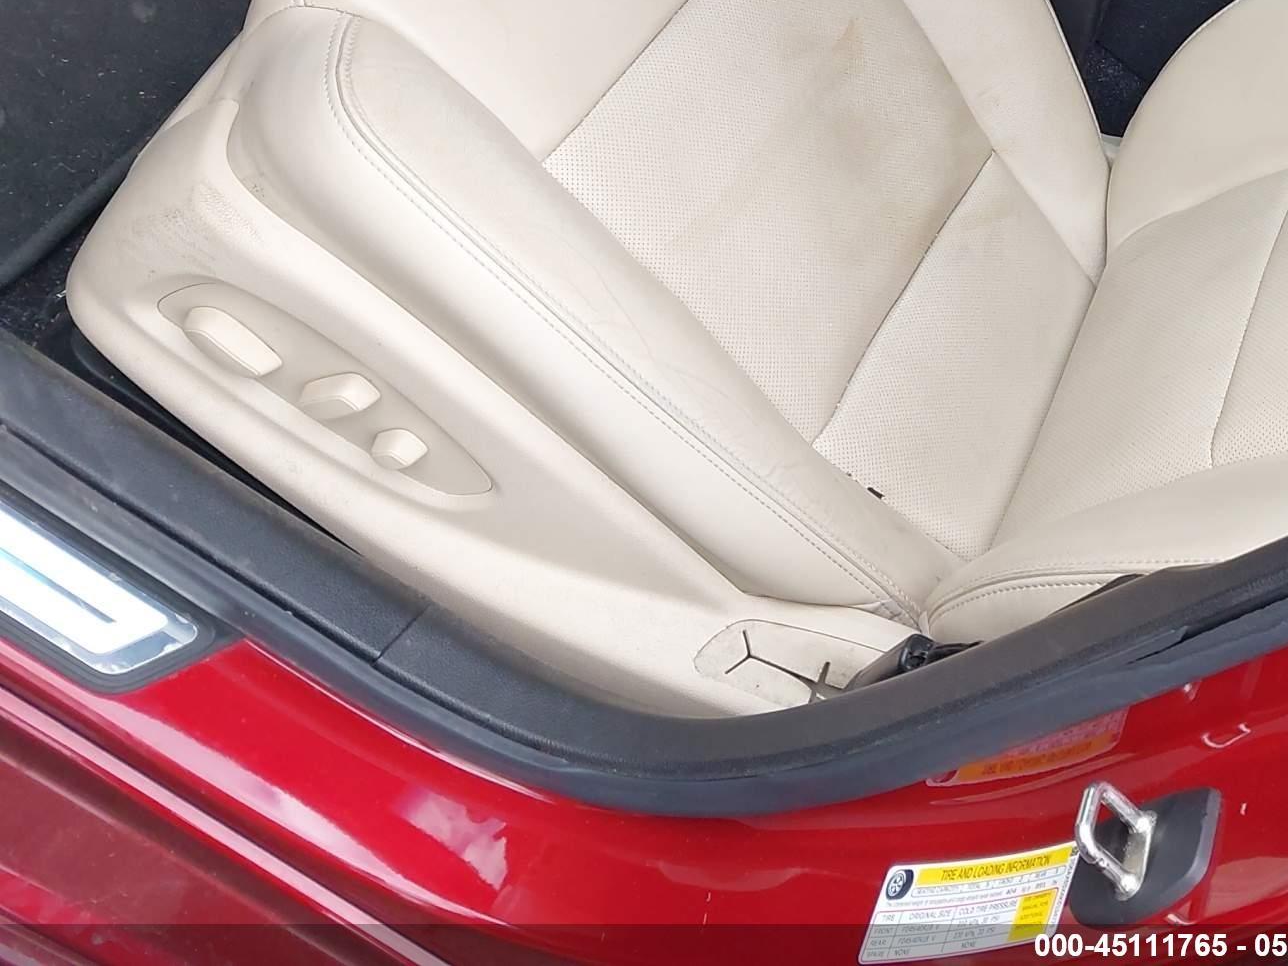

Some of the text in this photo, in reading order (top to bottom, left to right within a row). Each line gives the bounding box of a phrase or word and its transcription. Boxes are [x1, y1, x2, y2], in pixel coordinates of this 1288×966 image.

[941, 868, 959, 881] TIRE
[958, 865, 972, 879] AND
[973, 861, 1006, 879] LOADING
[1005, 854, 1051, 875] INFORMATION
